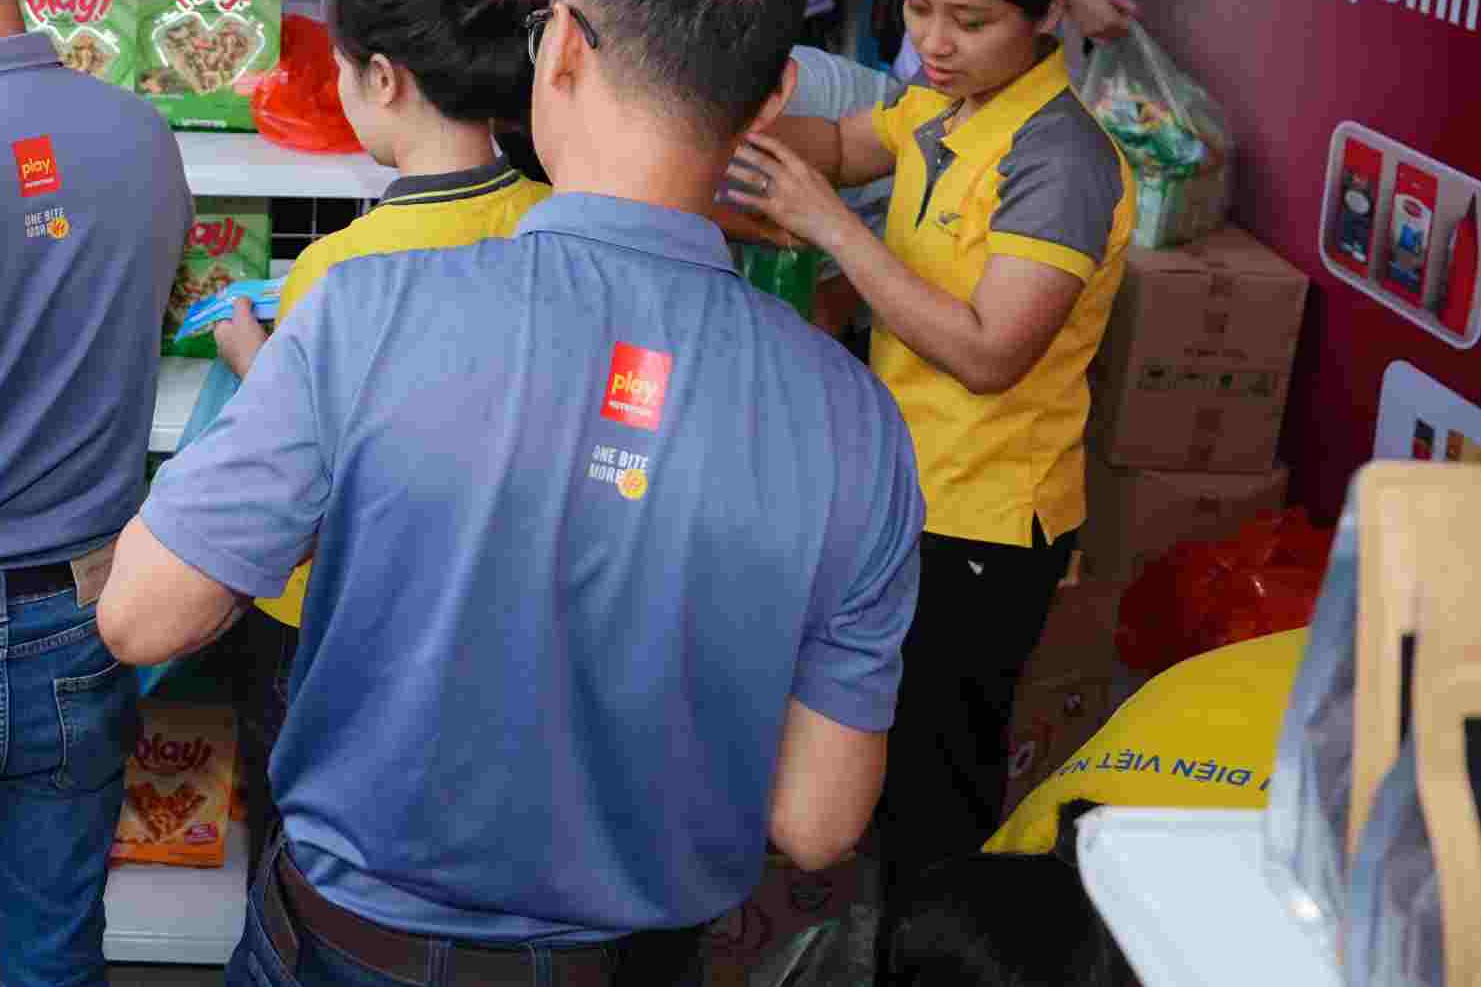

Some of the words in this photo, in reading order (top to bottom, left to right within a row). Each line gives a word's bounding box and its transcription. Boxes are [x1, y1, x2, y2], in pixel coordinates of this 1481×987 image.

[21, 156, 52, 179] play
[609, 370, 659, 405] play
[592, 445, 618, 464] ONE
[618, 449, 648, 470] BITE
[1095, 749, 1161, 773] VIỆT
